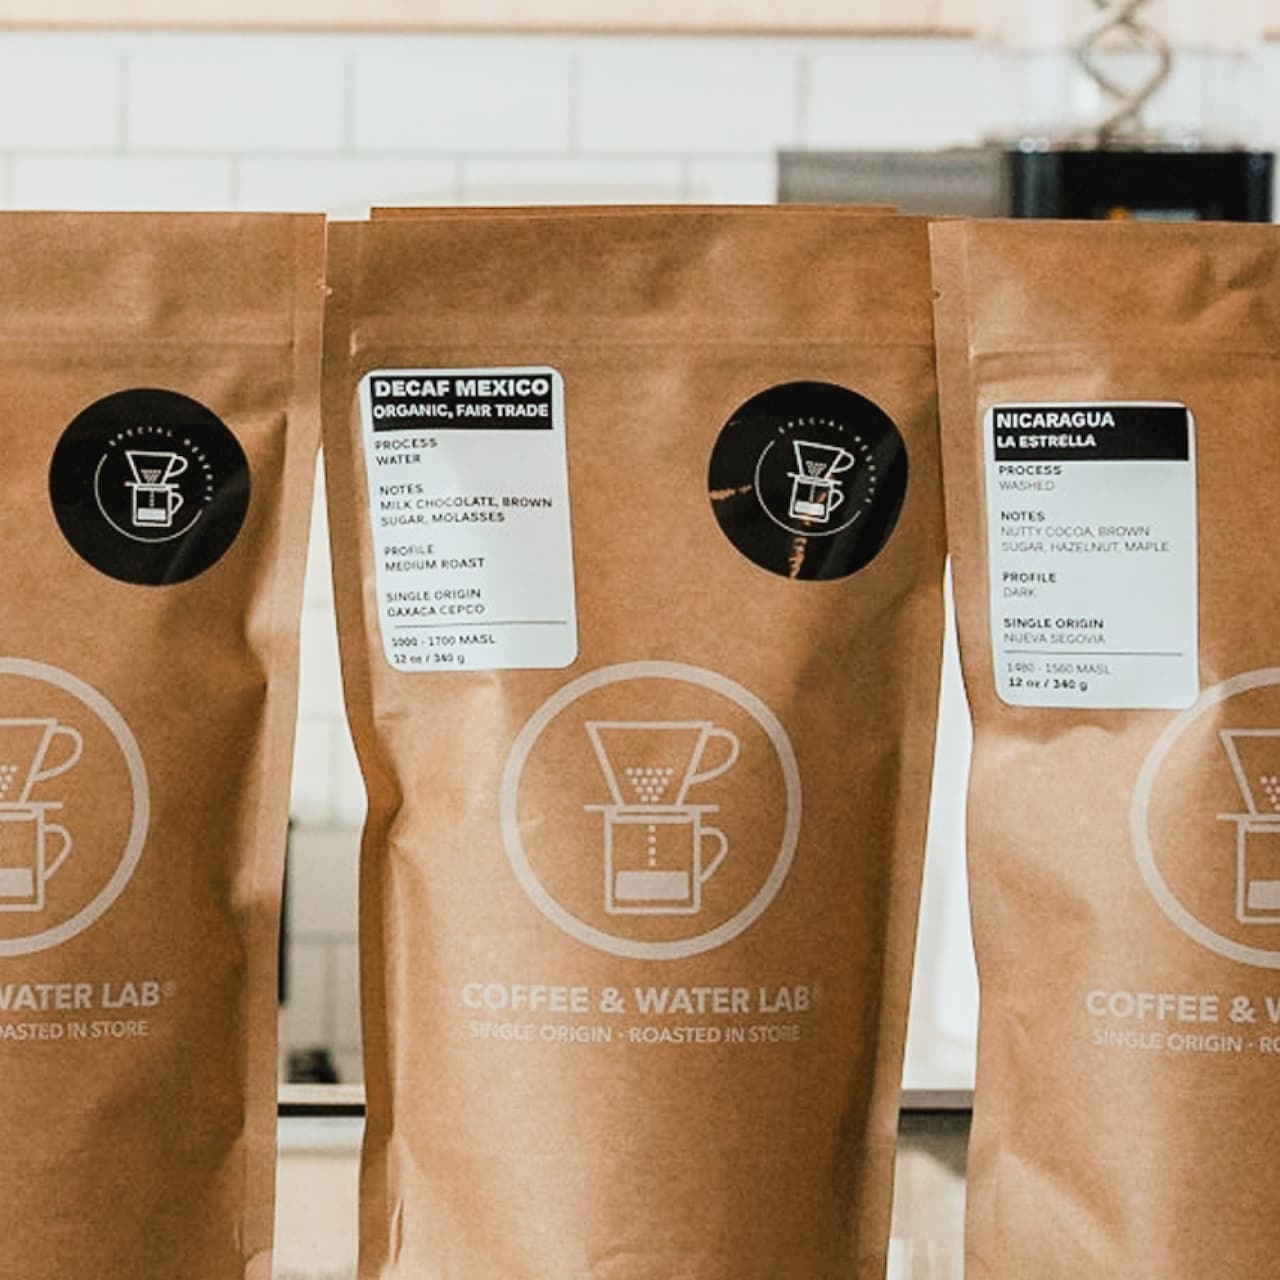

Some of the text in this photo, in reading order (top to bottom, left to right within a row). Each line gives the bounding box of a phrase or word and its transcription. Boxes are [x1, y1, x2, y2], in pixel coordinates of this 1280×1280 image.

[375, 379, 549, 397] DECAF MEXICO
[374, 403, 548, 418] ORGANIC, FAIR TRADE
[996, 412, 1115, 428] NICARAGUA
[375, 437, 438, 450] PROCESS
[997, 434, 1096, 448] LA ESTRELLA
[376, 454, 421, 466] WATER
[999, 465, 1062, 476] PROCESS
[379, 484, 423, 496] NOTES
[999, 480, 1055, 491] WASHED
[502, 497, 553, 508] BROWN
[1001, 511, 1045, 521] NOTES
[1003, 573, 1056, 583] PROFILE
[1004, 618, 1104, 629] SINGLE ORIGIN
[461, 982, 588, 1013] COFFEE
[599, 986, 625, 1014] &
[634, 986, 750, 1014] WATER
[1086, 990, 1219, 1022] COFFEE
[1229, 995, 1255, 1023] &
[67, 1022, 88, 1039] IN
[91, 1020, 150, 1038] STORE
[541, 1025, 611, 1042] ORIGIN
[629, 1026, 719, 1043] ROASTED
[725, 1025, 744, 1042] IN
[749, 1024, 800, 1041] STORE
[1094, 1031, 1243, 1053] SINGLE ORIGIN
